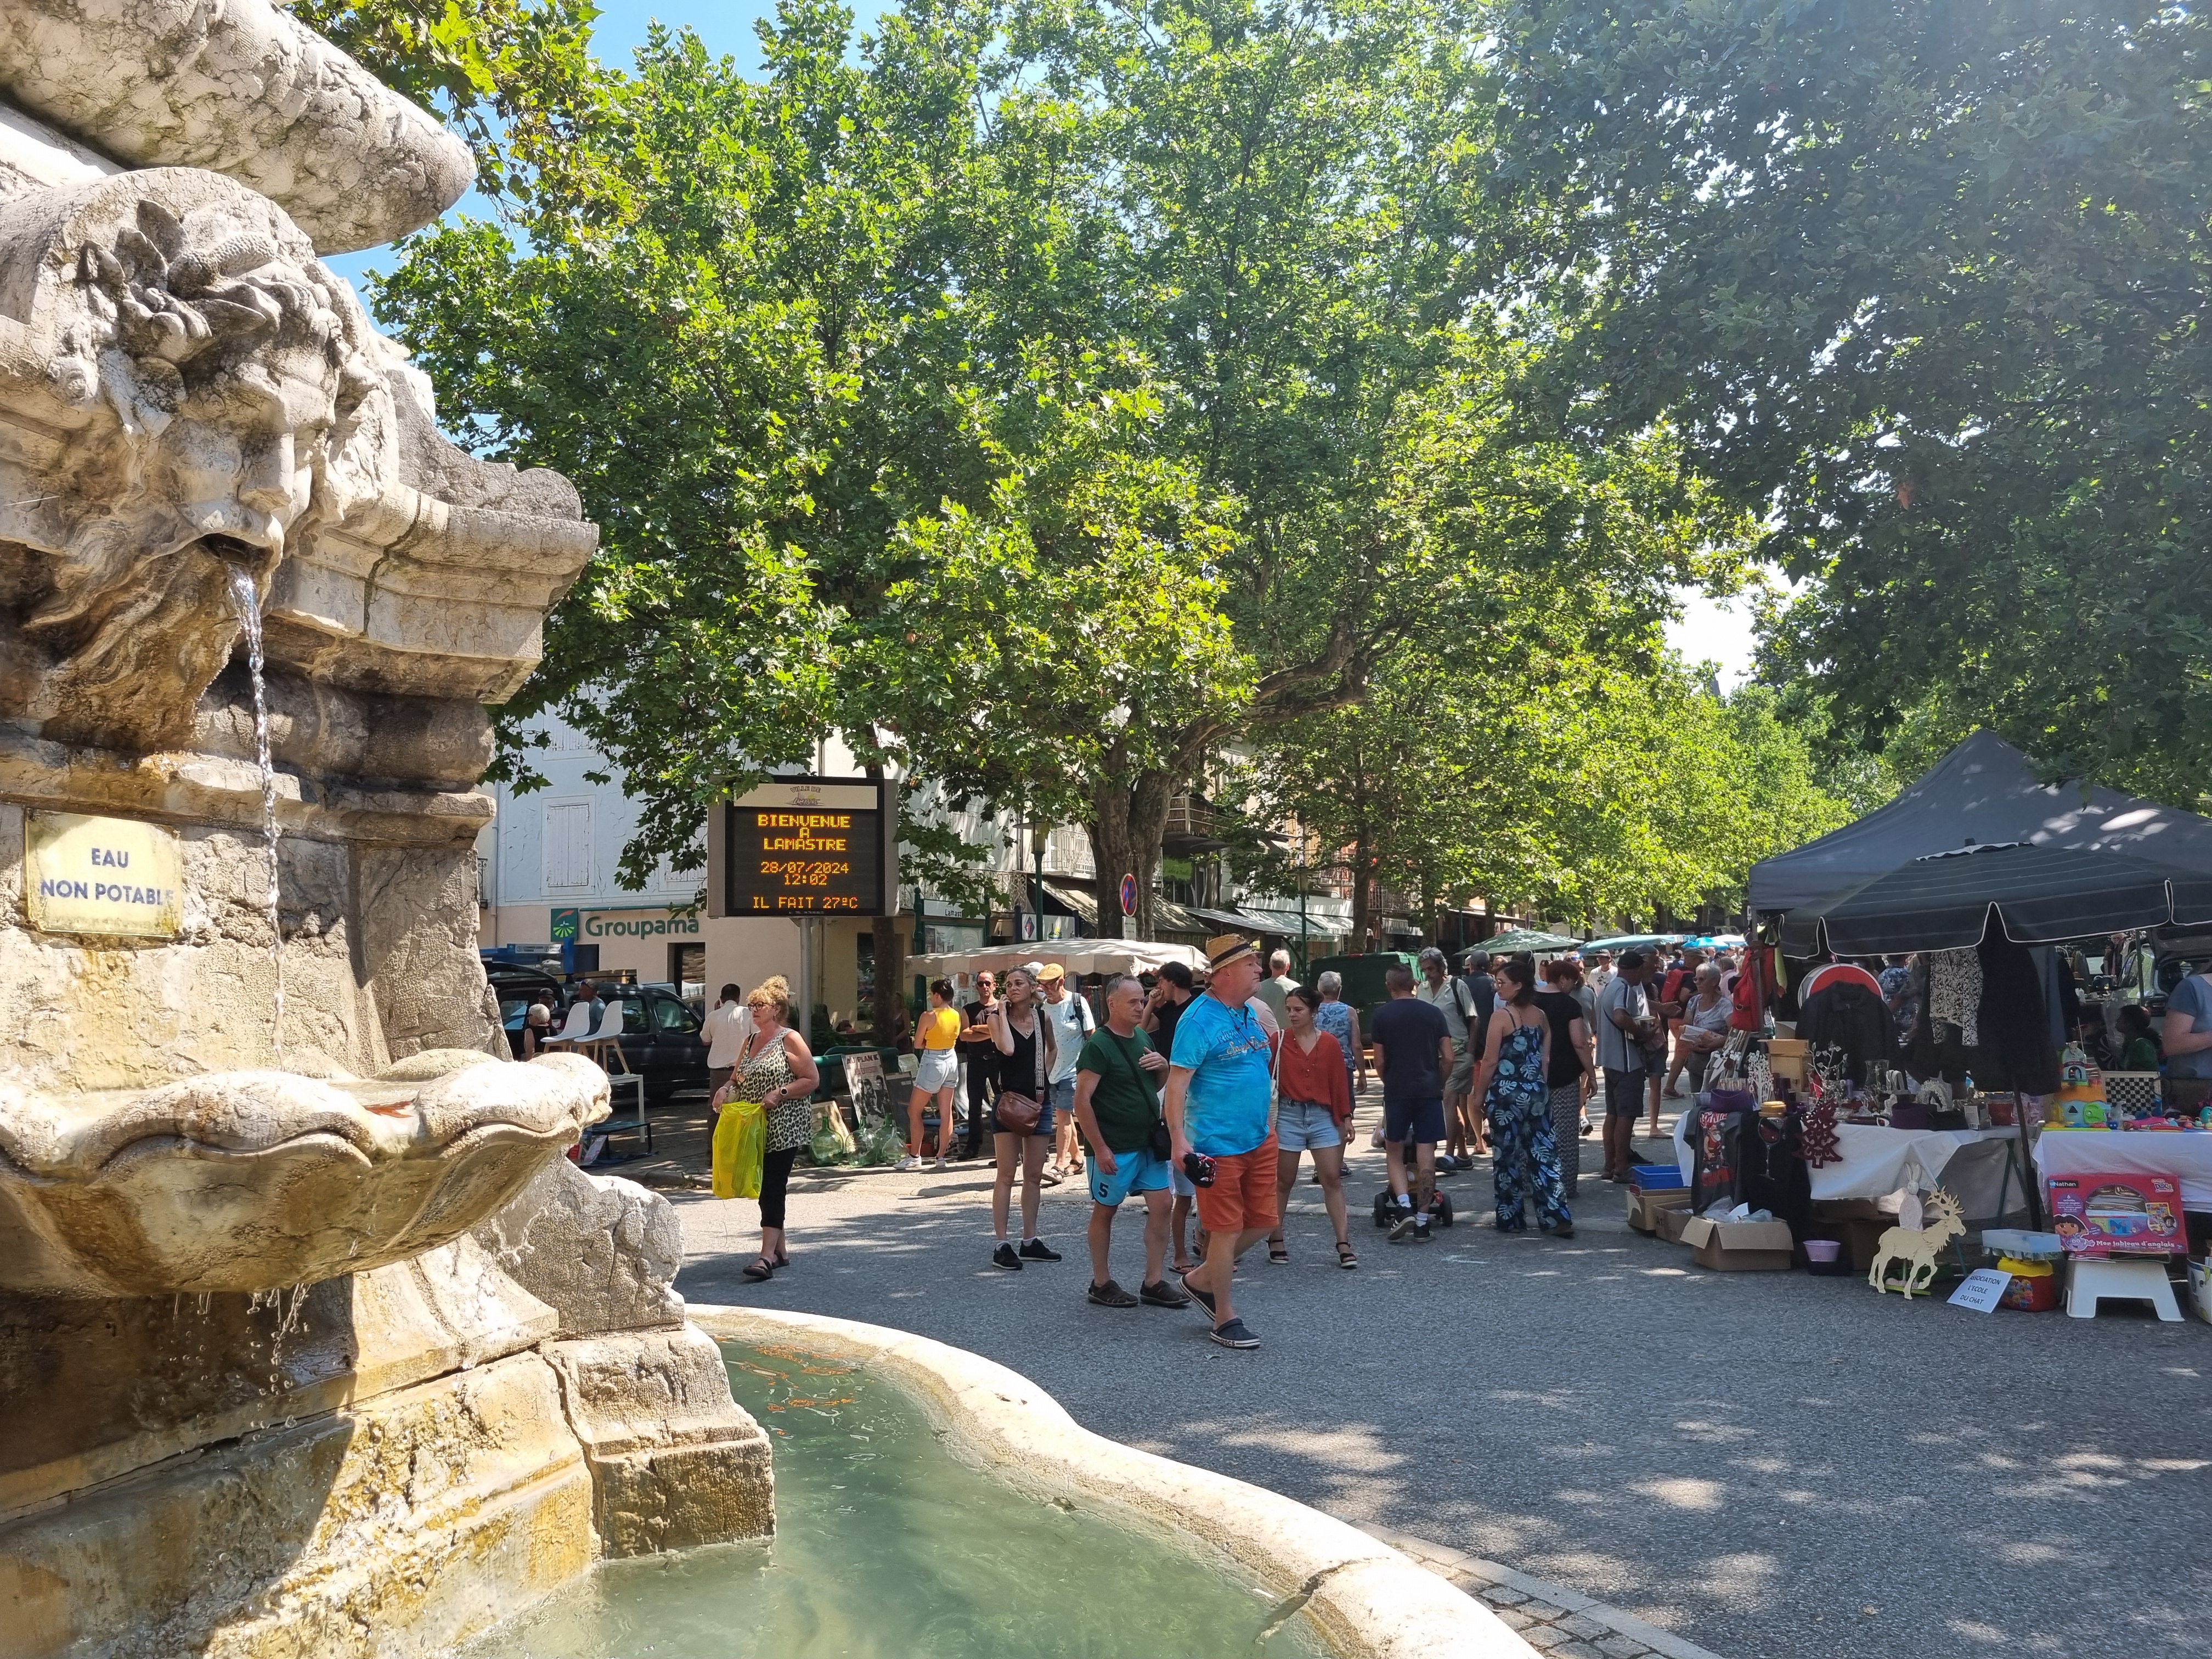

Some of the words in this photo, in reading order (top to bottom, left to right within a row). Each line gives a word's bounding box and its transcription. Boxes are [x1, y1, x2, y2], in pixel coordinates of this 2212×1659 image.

[758, 814, 850, 828] BIENVENUE
[799, 827, 810, 838] A
[763, 838, 847, 851] LAMASTRE
[91, 848, 129, 868] EAU
[760, 861, 849, 873] 28/07/2024
[784, 874, 827, 885] 12:02
[40, 879, 88, 899] NON
[753, 896, 770, 909] IL
[778, 896, 814, 909] FAIT
[585, 916, 699, 940] Groupama
[1098, 1182, 1109, 1198] 5
[1967, 1285, 1989, 1294] L'ECOLE
